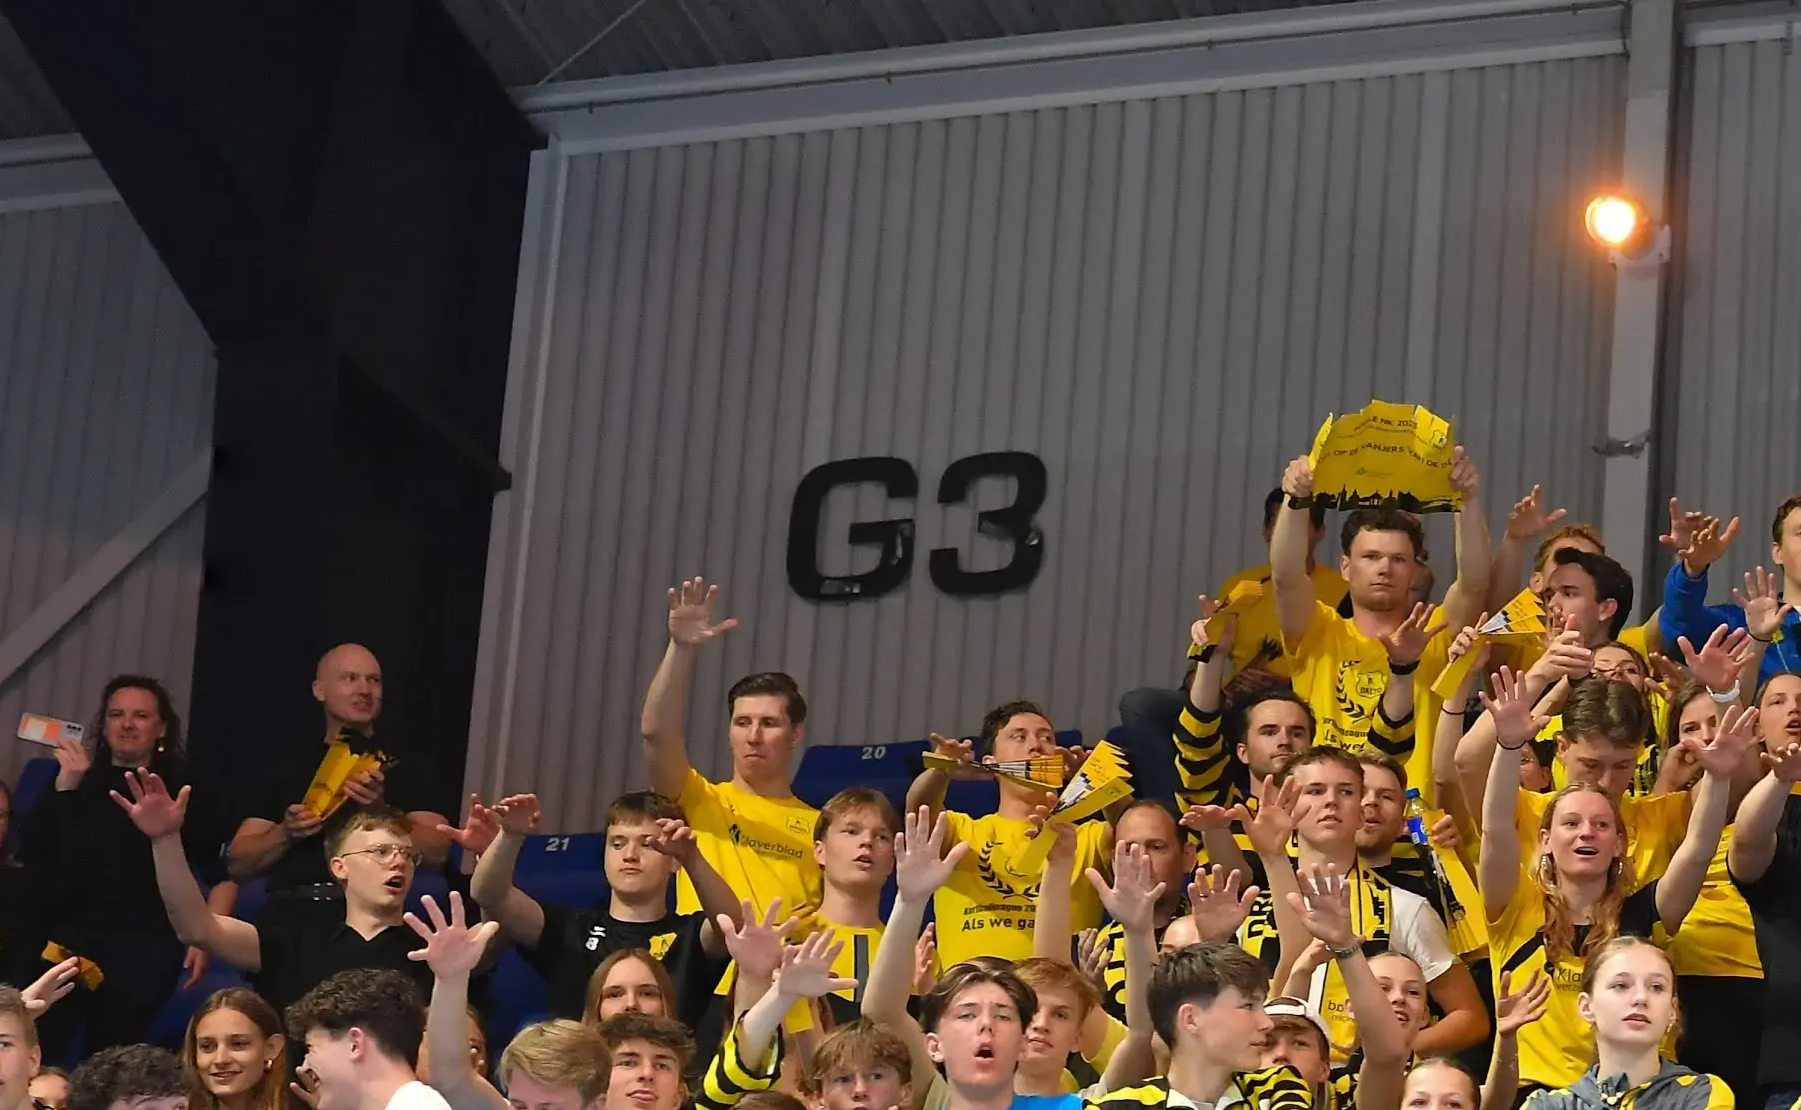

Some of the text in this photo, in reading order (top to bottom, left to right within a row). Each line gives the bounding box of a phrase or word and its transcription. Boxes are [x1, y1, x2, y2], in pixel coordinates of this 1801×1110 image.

[786, 452, 1048, 601] G3
[861, 746, 886, 761] 20
[545, 838, 570, 852] 21
[962, 917, 1035, 932] Als we ga
